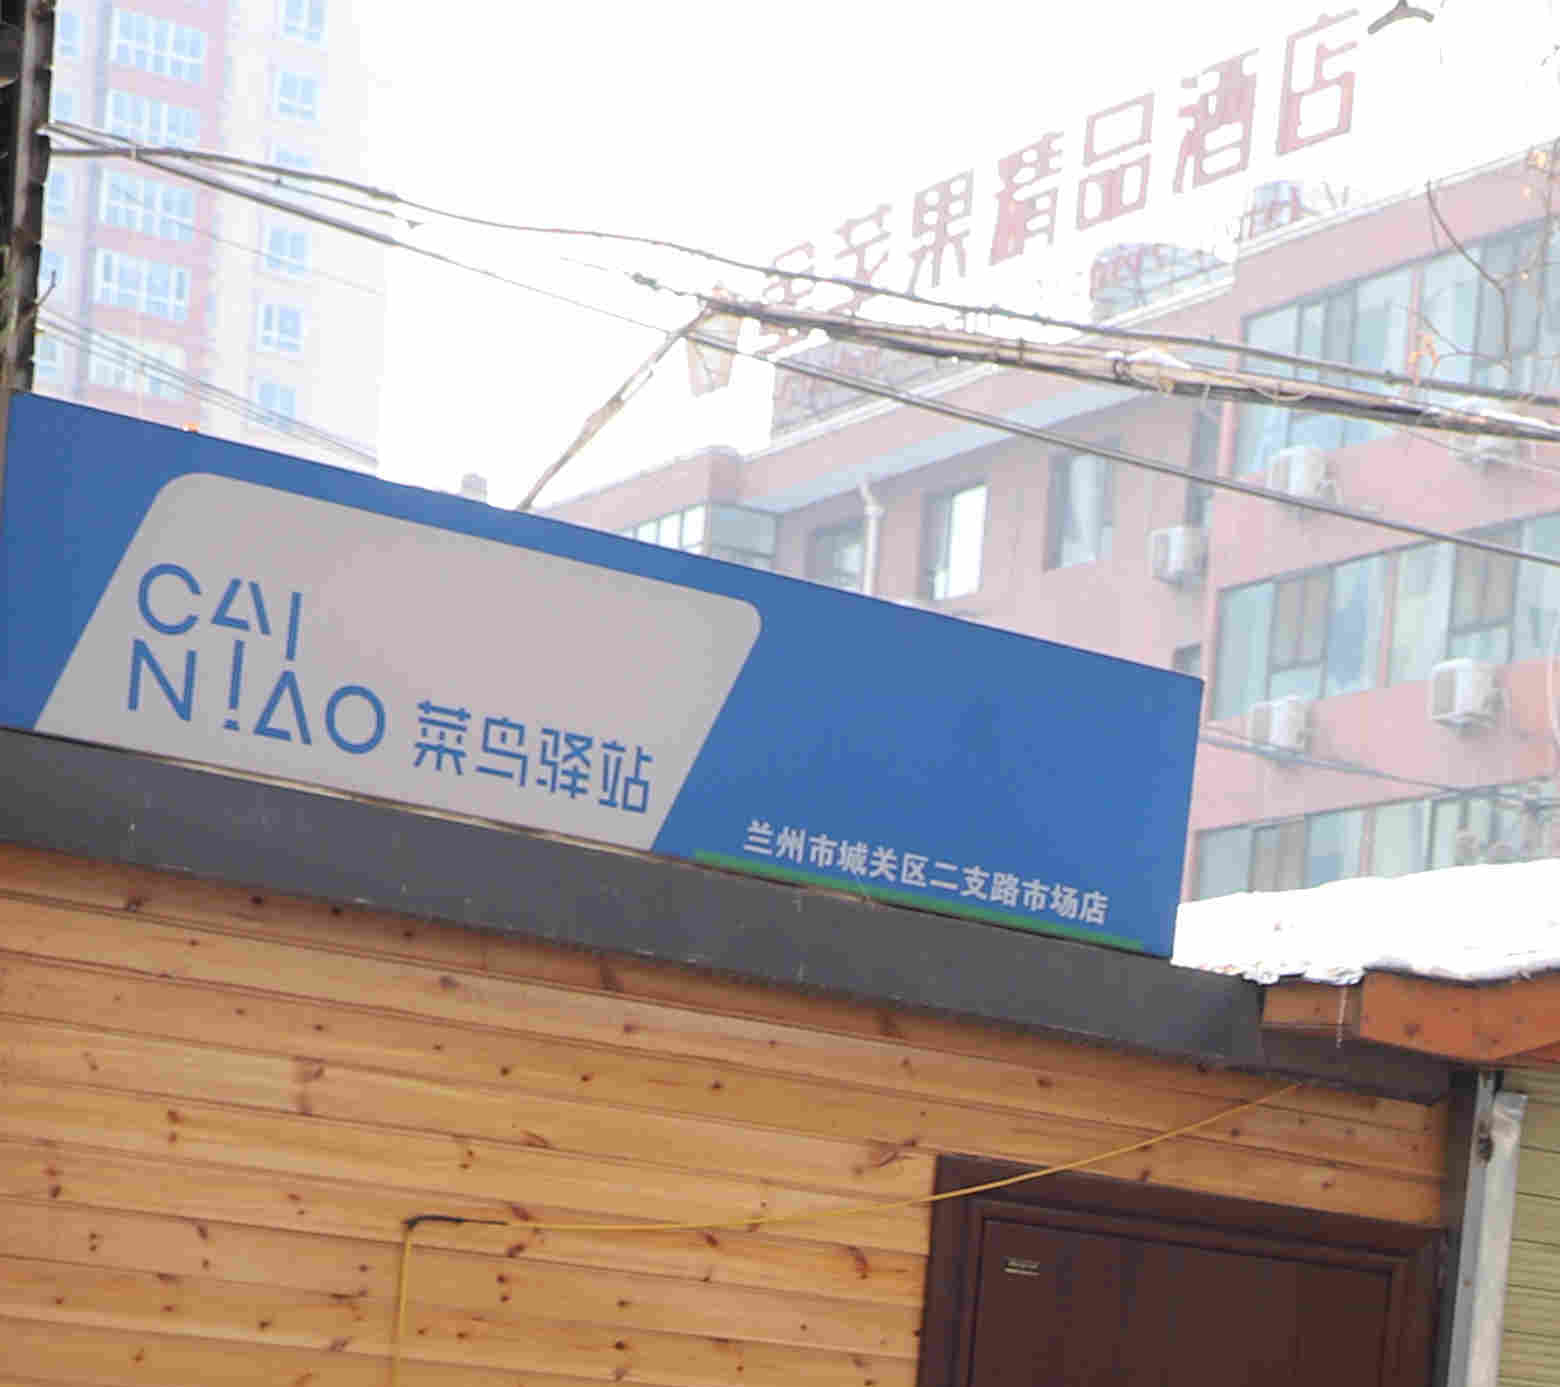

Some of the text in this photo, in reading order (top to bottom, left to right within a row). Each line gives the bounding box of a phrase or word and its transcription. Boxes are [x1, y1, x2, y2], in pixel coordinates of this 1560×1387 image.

[137, 561, 302, 662] CAI
[127, 638, 386, 756] NIAO
[414, 698, 654, 814] 菜鸟驿站
[741, 819, 1111, 928] 兰州市城关区二支路市场店
